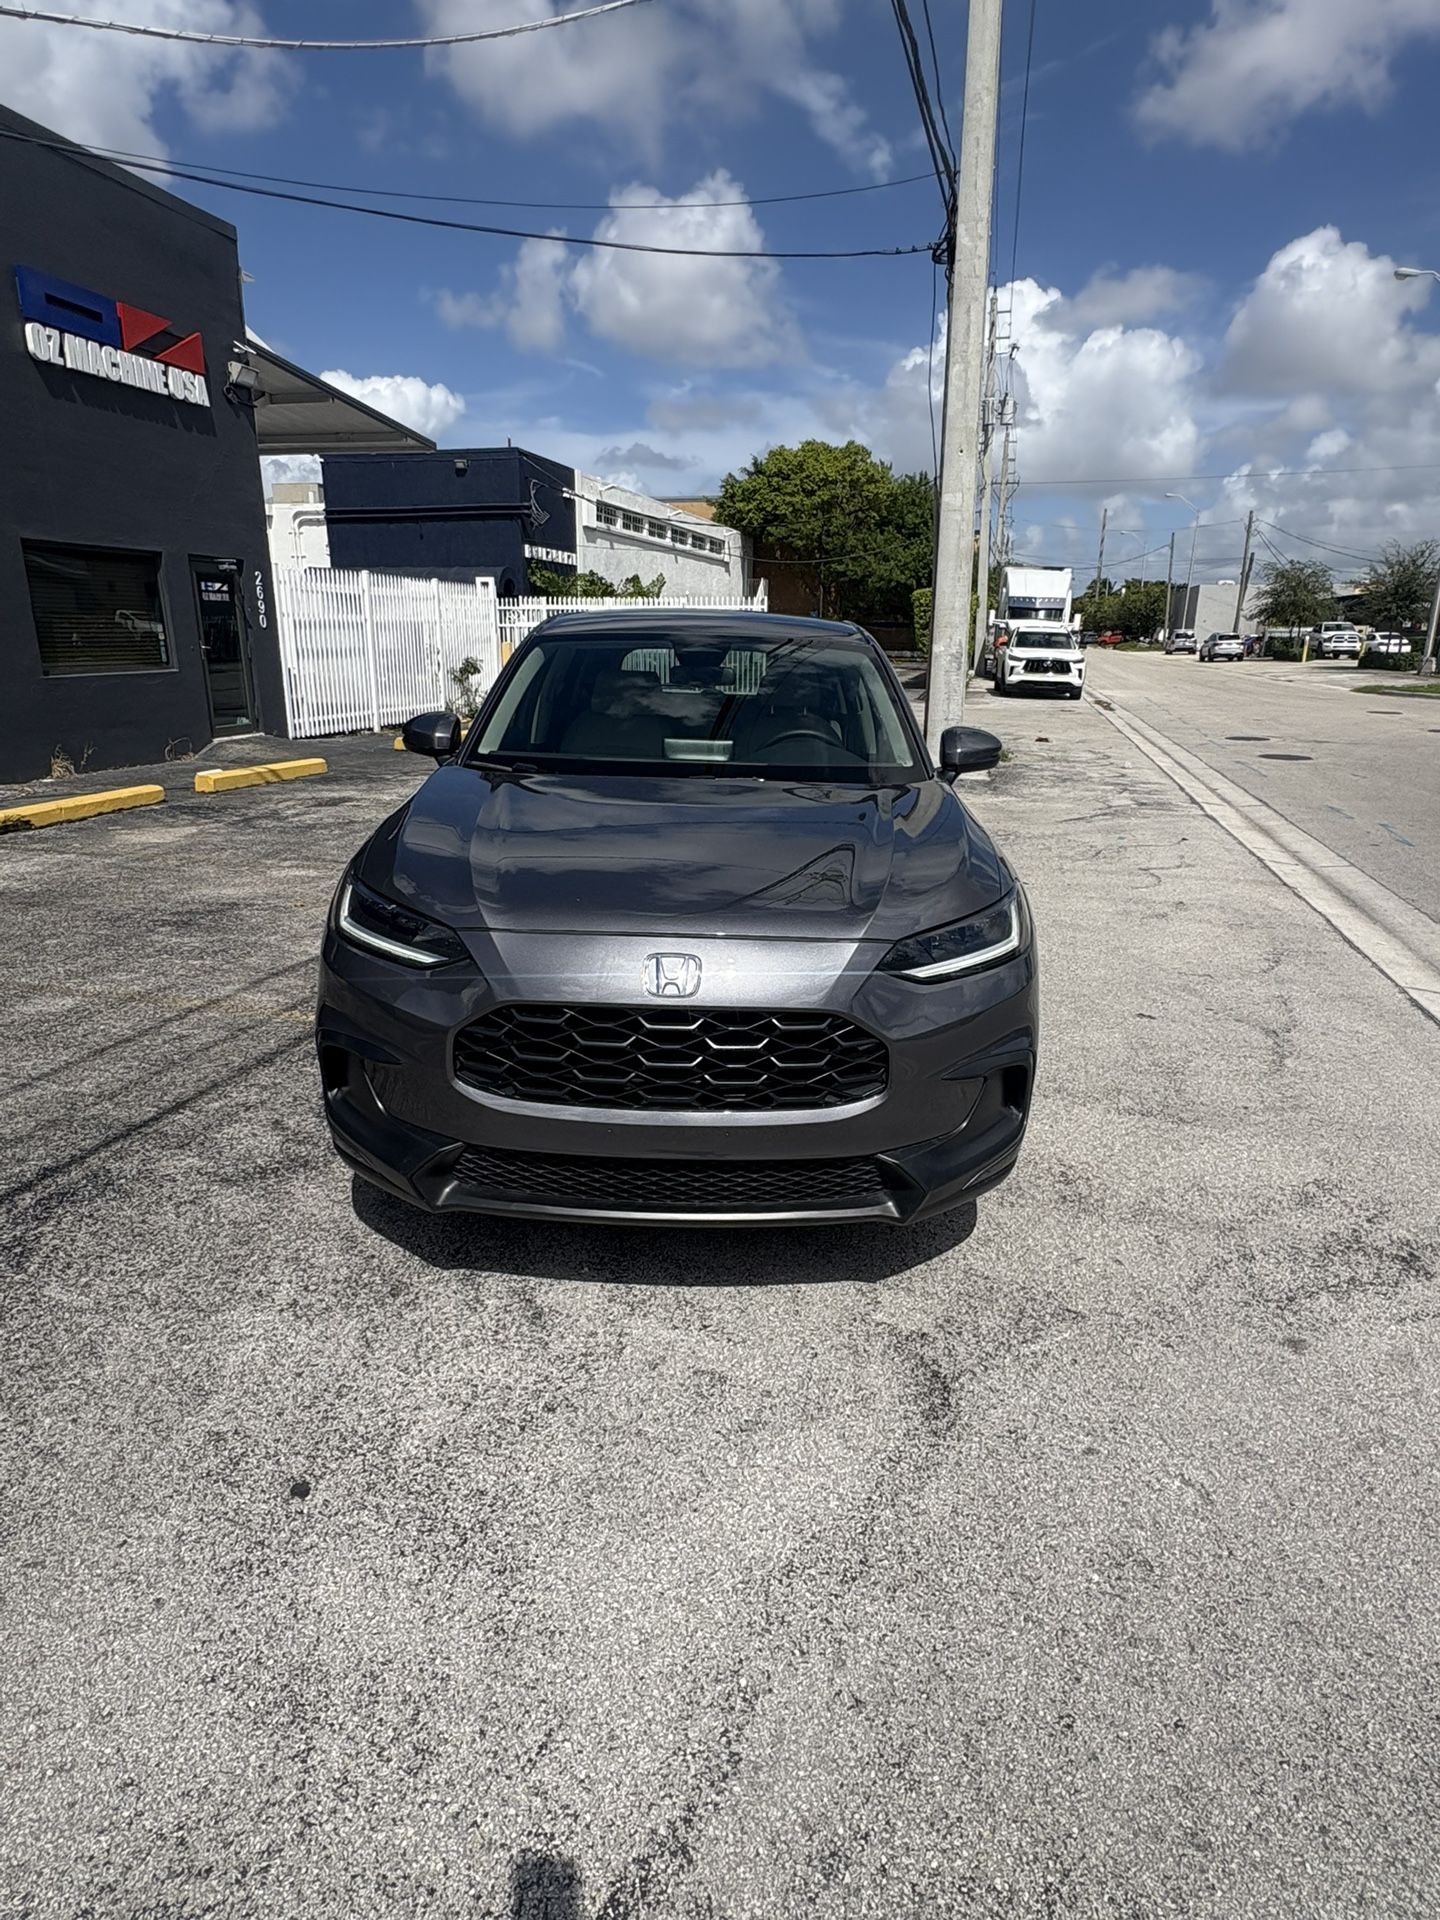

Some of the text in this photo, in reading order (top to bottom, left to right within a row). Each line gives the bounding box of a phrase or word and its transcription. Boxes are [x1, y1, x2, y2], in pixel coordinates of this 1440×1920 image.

[25, 322, 210, 407] OZ MACHINE USA
[254, 570, 267, 629] 2690
